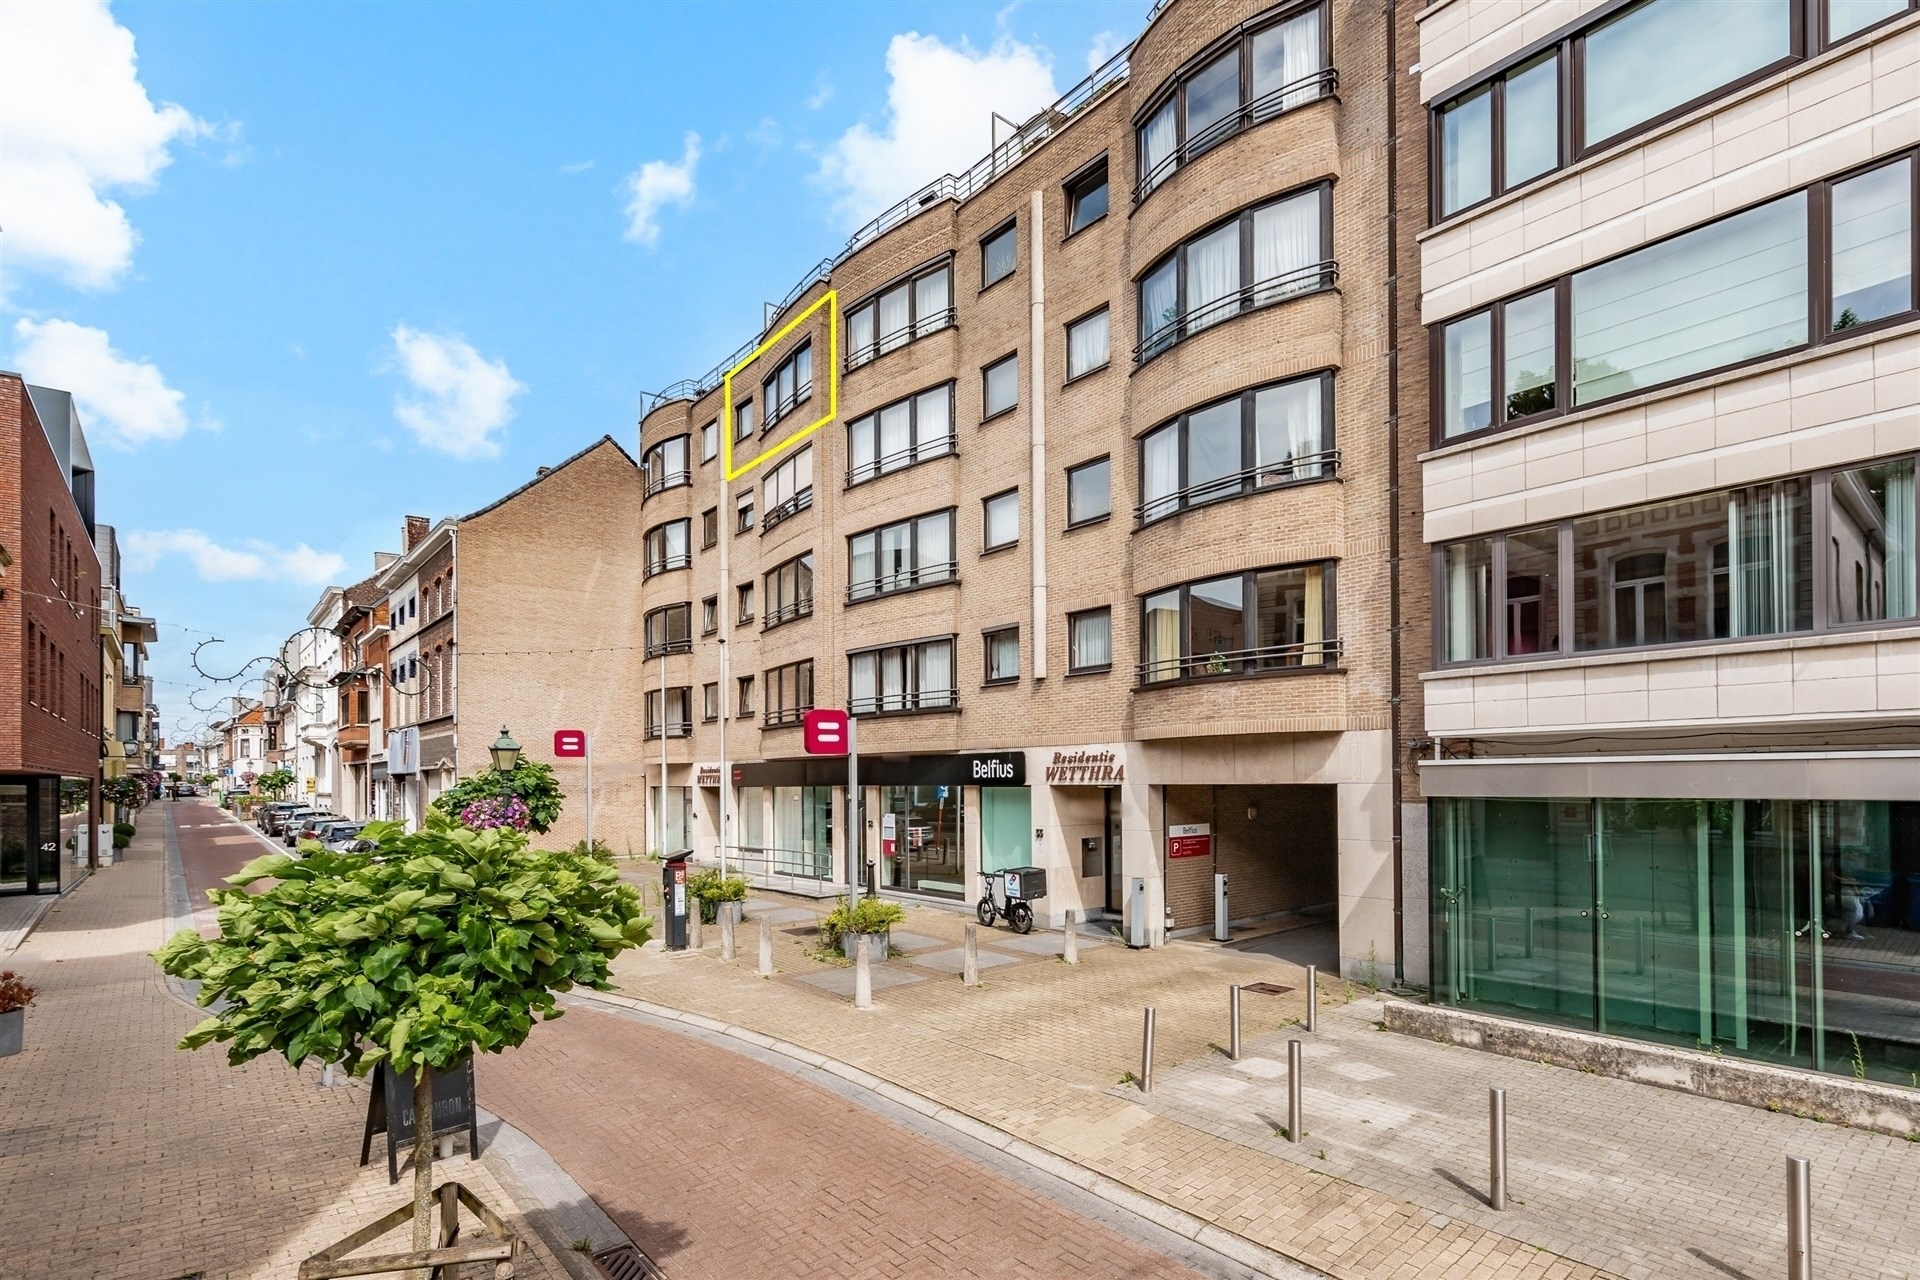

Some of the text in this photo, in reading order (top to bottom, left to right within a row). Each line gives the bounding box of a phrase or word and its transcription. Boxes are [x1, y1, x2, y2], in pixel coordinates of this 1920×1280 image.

[1053, 750, 1116, 765] Residentie
[973, 759, 1014, 779] Belfius
[1046, 765, 1125, 782] WETTHRA
[40, 842, 57, 851] 42
[1173, 842, 1179, 853] P
